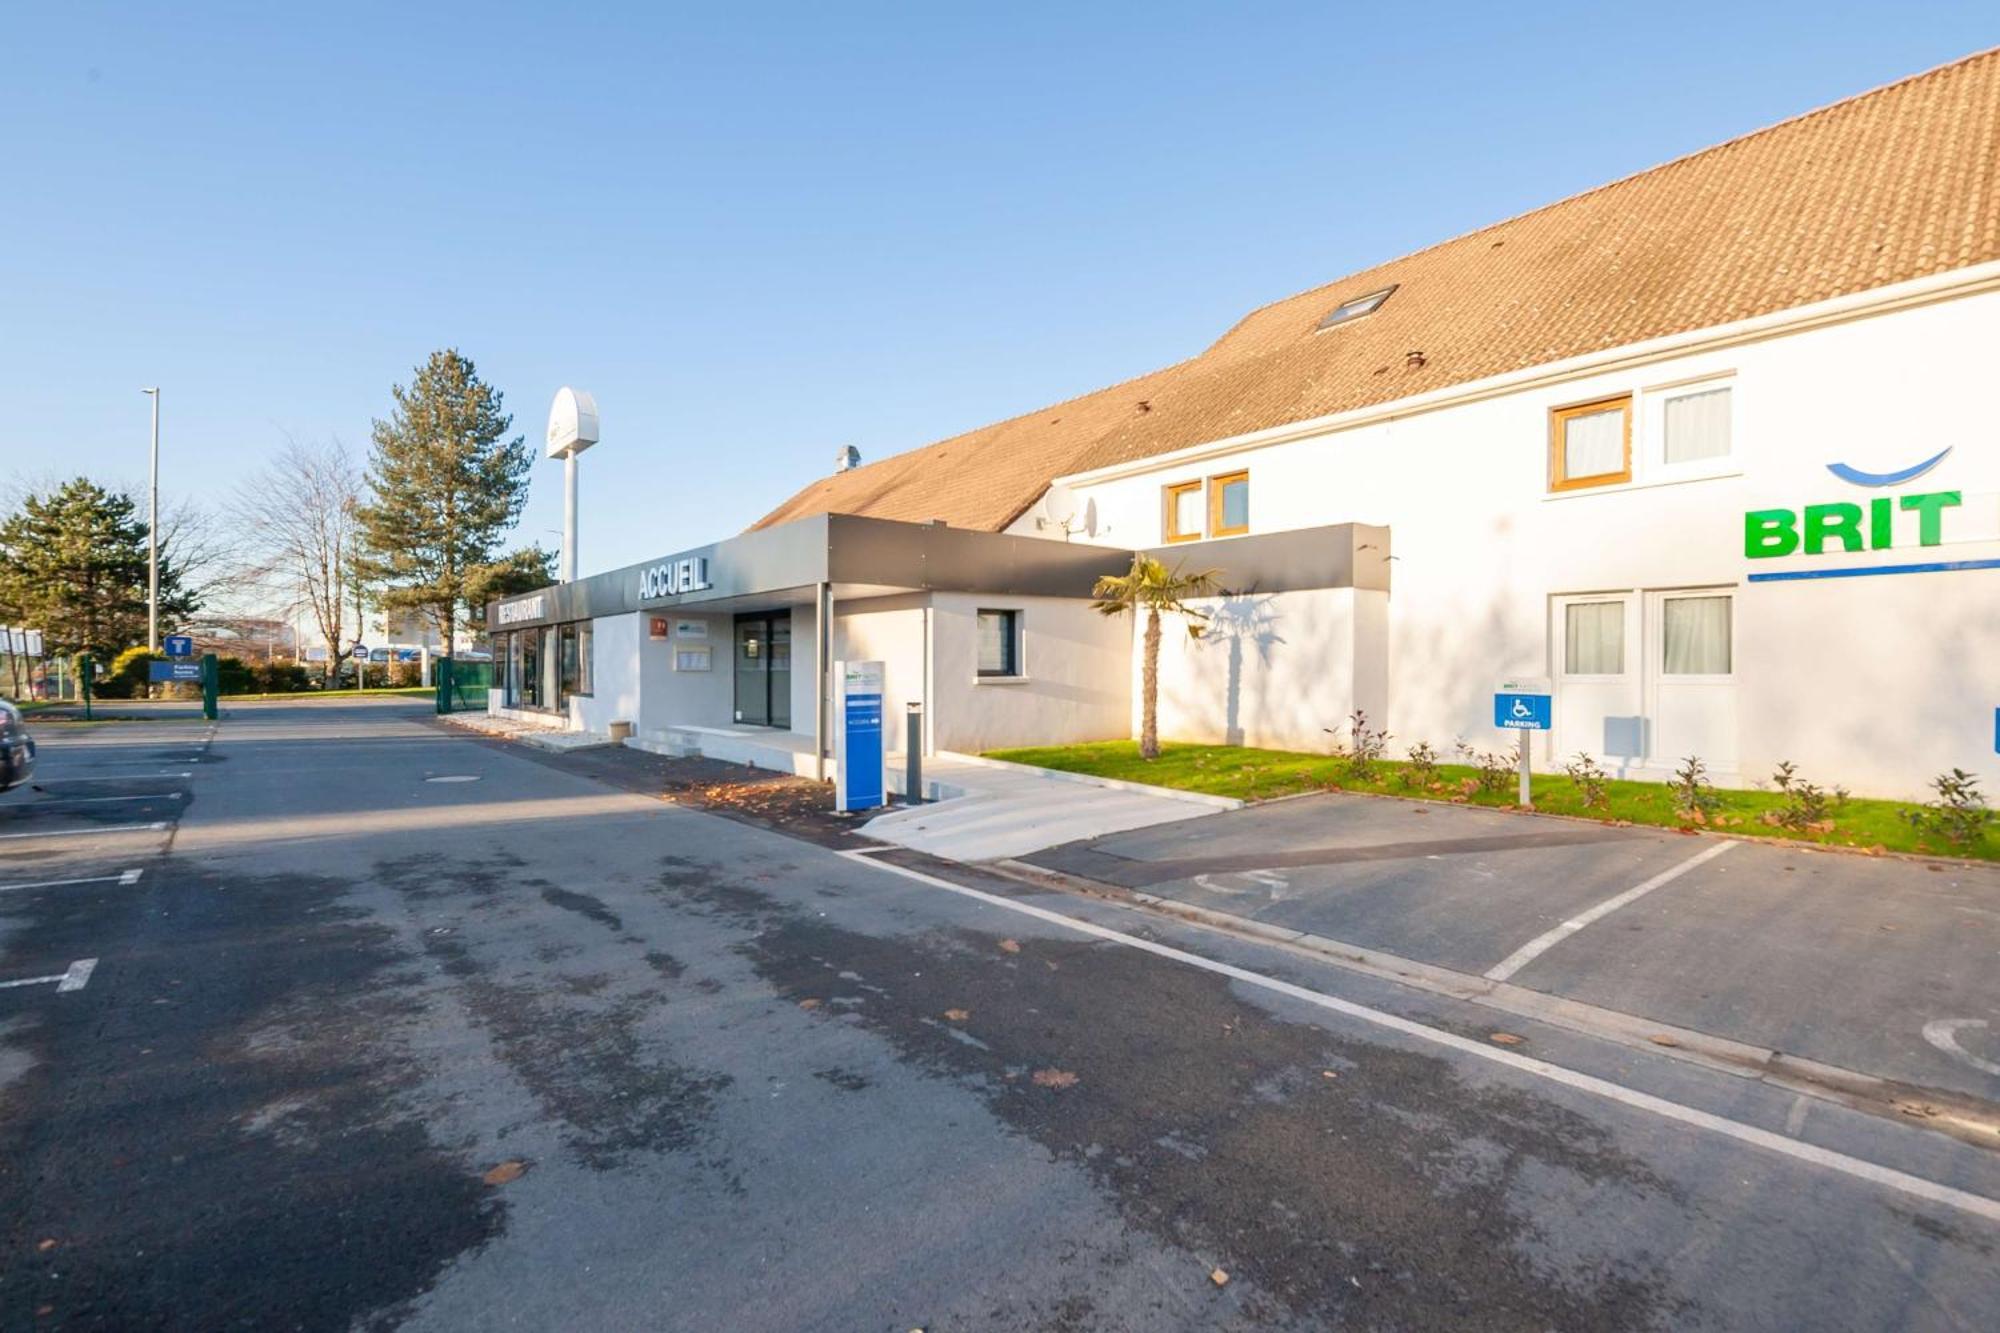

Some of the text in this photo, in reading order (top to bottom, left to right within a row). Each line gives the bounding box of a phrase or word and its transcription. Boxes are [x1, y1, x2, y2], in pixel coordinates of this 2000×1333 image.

[1745, 490, 1962, 559] BRIT
[638, 556, 708, 600] ACCUEIL
[498, 596, 543, 625] RESTAURANT
[1503, 719, 1542, 729] PARKING
